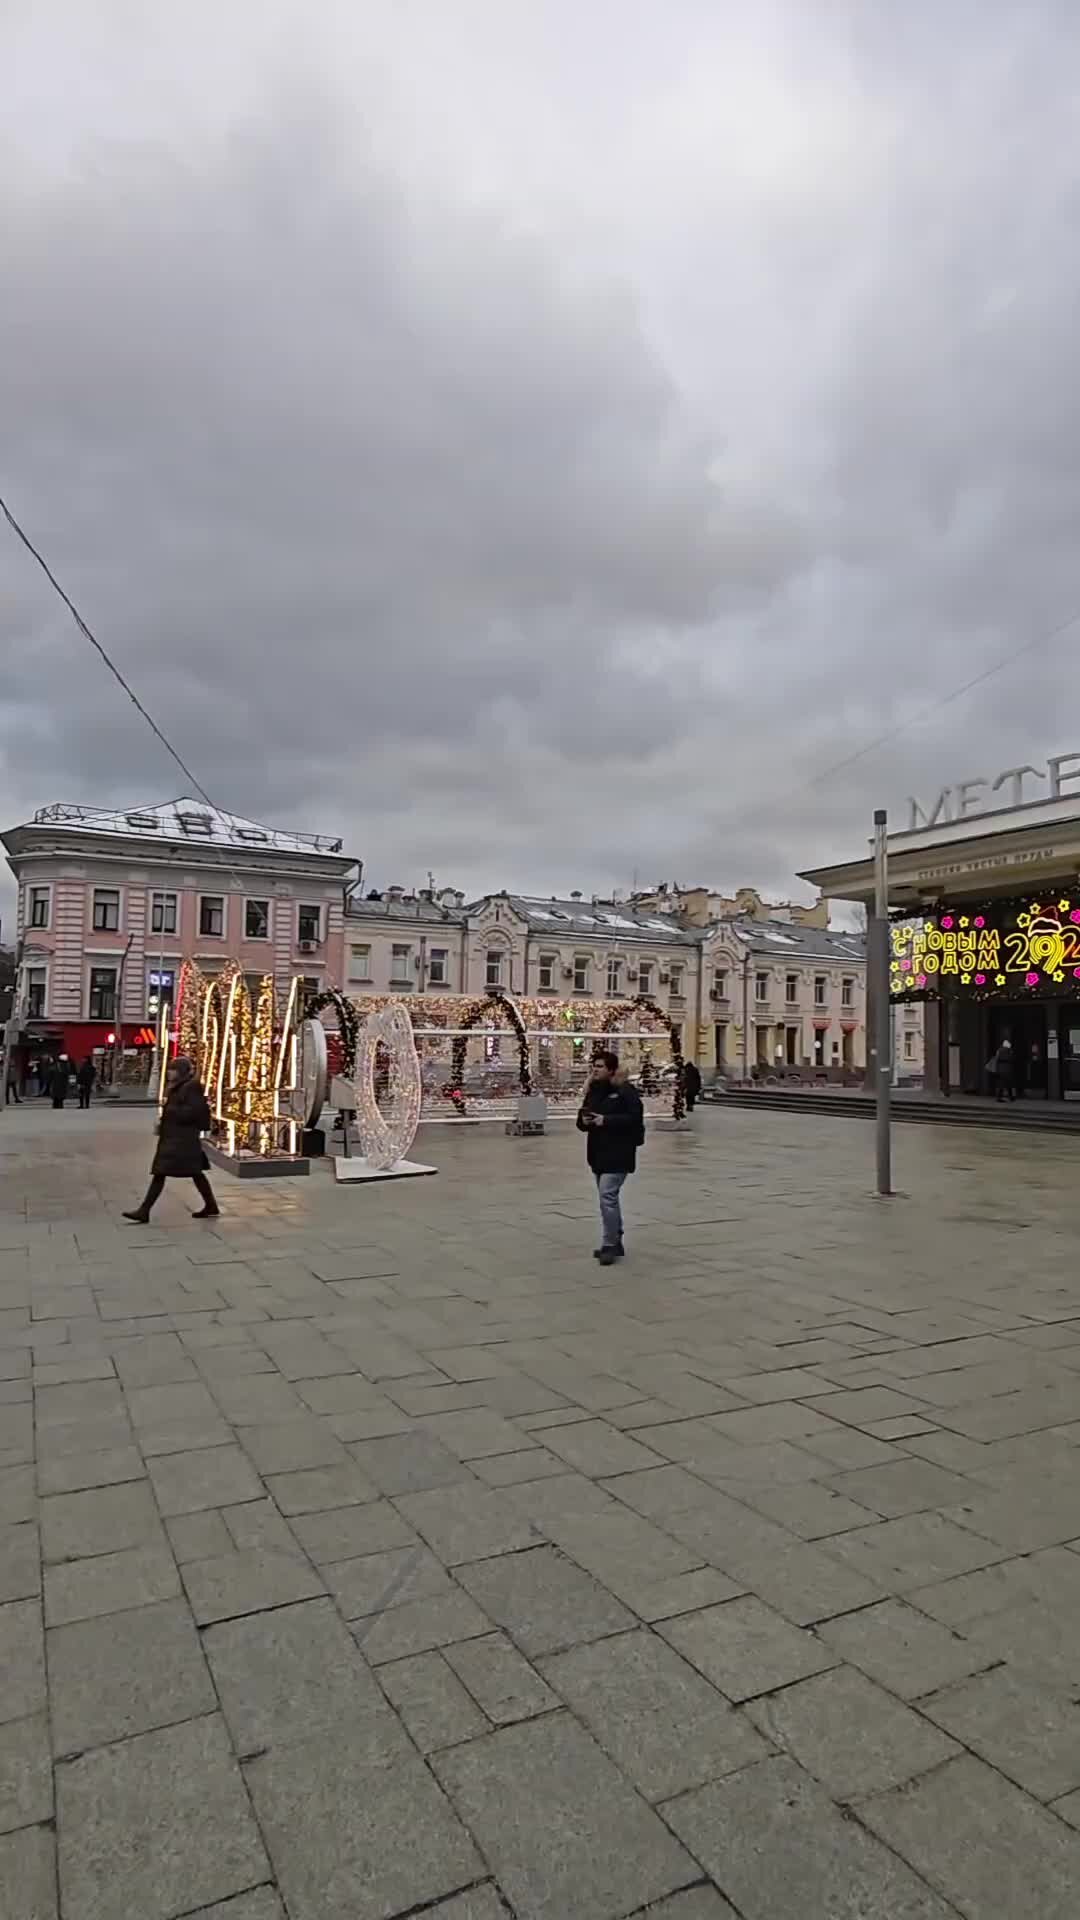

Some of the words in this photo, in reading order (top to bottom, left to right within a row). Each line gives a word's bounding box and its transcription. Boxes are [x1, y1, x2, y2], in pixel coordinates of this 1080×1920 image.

[893, 938, 907, 957] С
[912, 929, 1000, 954] НОВЫМ
[912, 949, 999, 974] ГОДОМ
